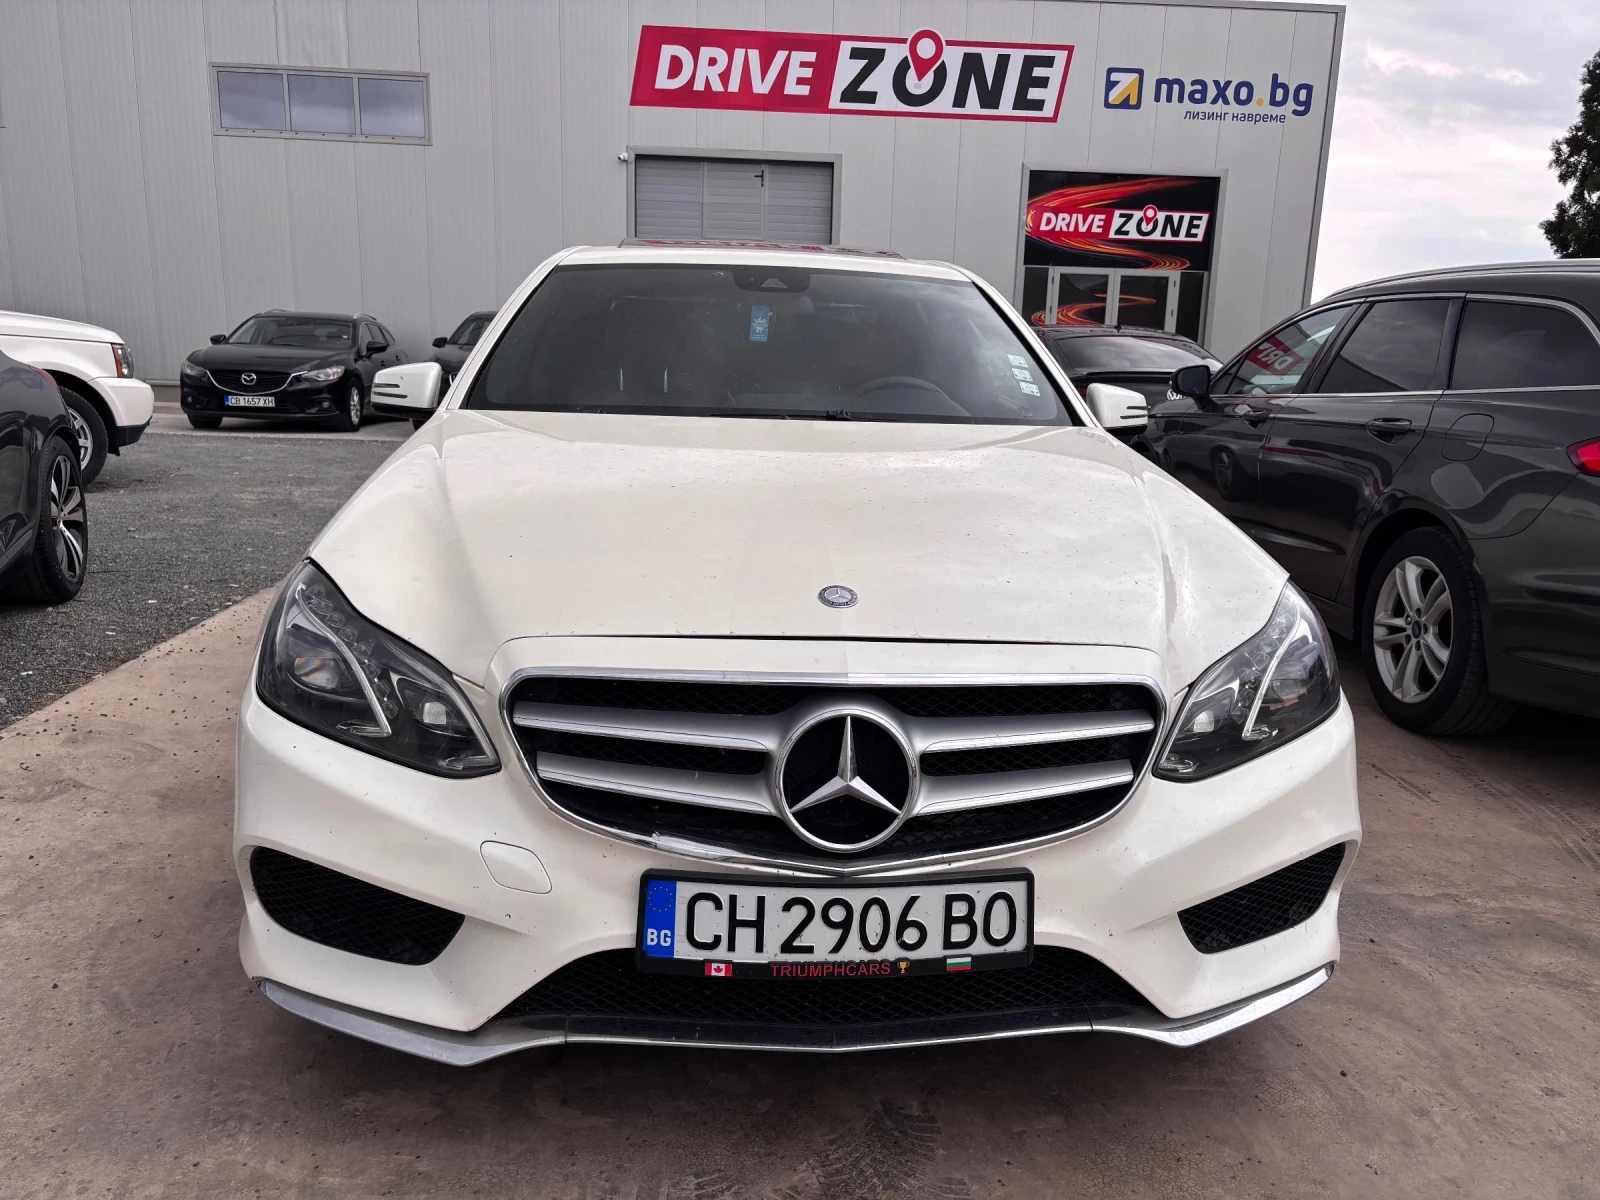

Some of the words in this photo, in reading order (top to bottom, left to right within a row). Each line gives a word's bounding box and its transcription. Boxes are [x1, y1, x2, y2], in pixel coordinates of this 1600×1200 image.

[654, 44, 817, 96] DRIVE
[839, 47, 1056, 111] ZONE
[1153, 73, 1314, 117] maxo.bg
[1183, 110, 1229, 122] лизинг
[1231, 111, 1286, 125] навреме
[1039, 212, 1106, 233] DRIVE
[1114, 212, 1203, 239] ZONE
[230, 397, 241, 405] CB
[243, 397, 261, 406] 1657
[685, 892, 766, 953] CH
[780, 895, 928, 954] 2906
[942, 891, 1018, 951] BO
[646, 928, 672, 947] BG
[770, 962, 891, 977] TRIUMPHCARS
